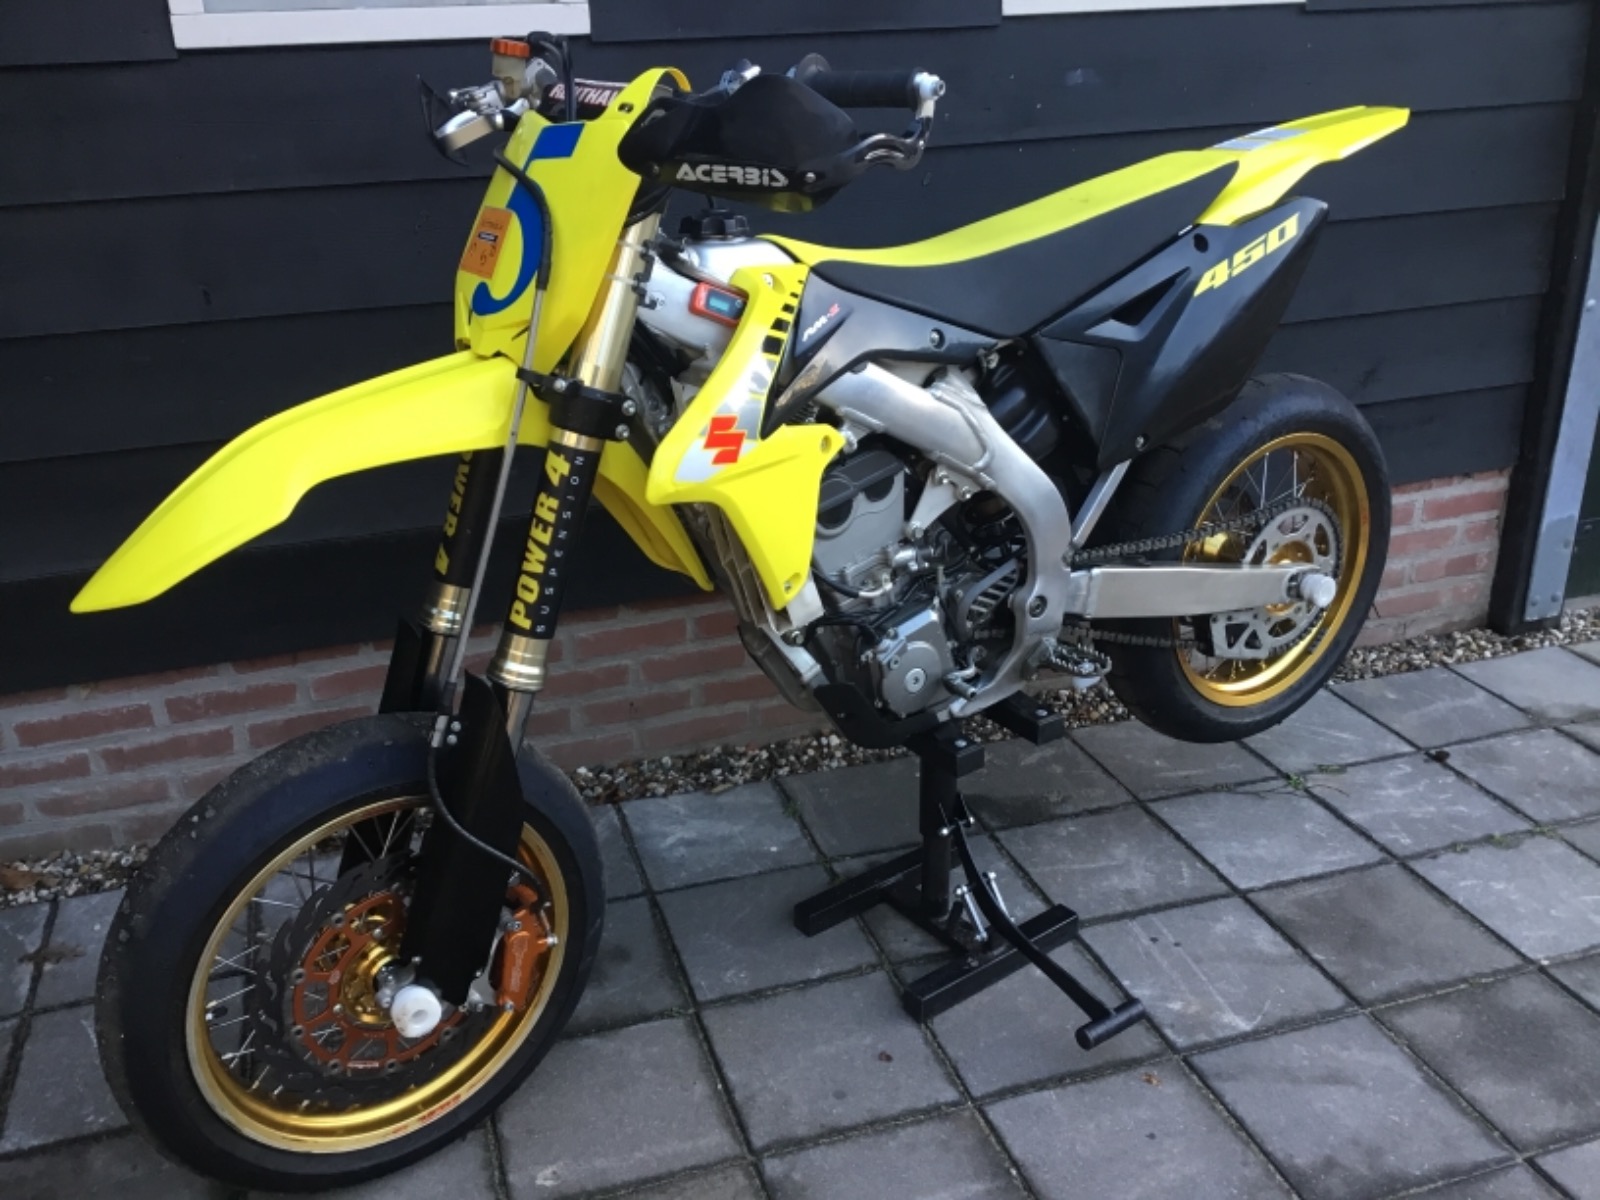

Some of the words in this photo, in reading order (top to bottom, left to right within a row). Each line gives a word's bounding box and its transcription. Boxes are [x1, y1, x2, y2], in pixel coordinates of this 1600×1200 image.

[1193, 211, 1300, 298] 450
[509, 491, 560, 630] POWER
[545, 449, 571, 488] 4
[535, 455, 586, 633] SUSPENSION
